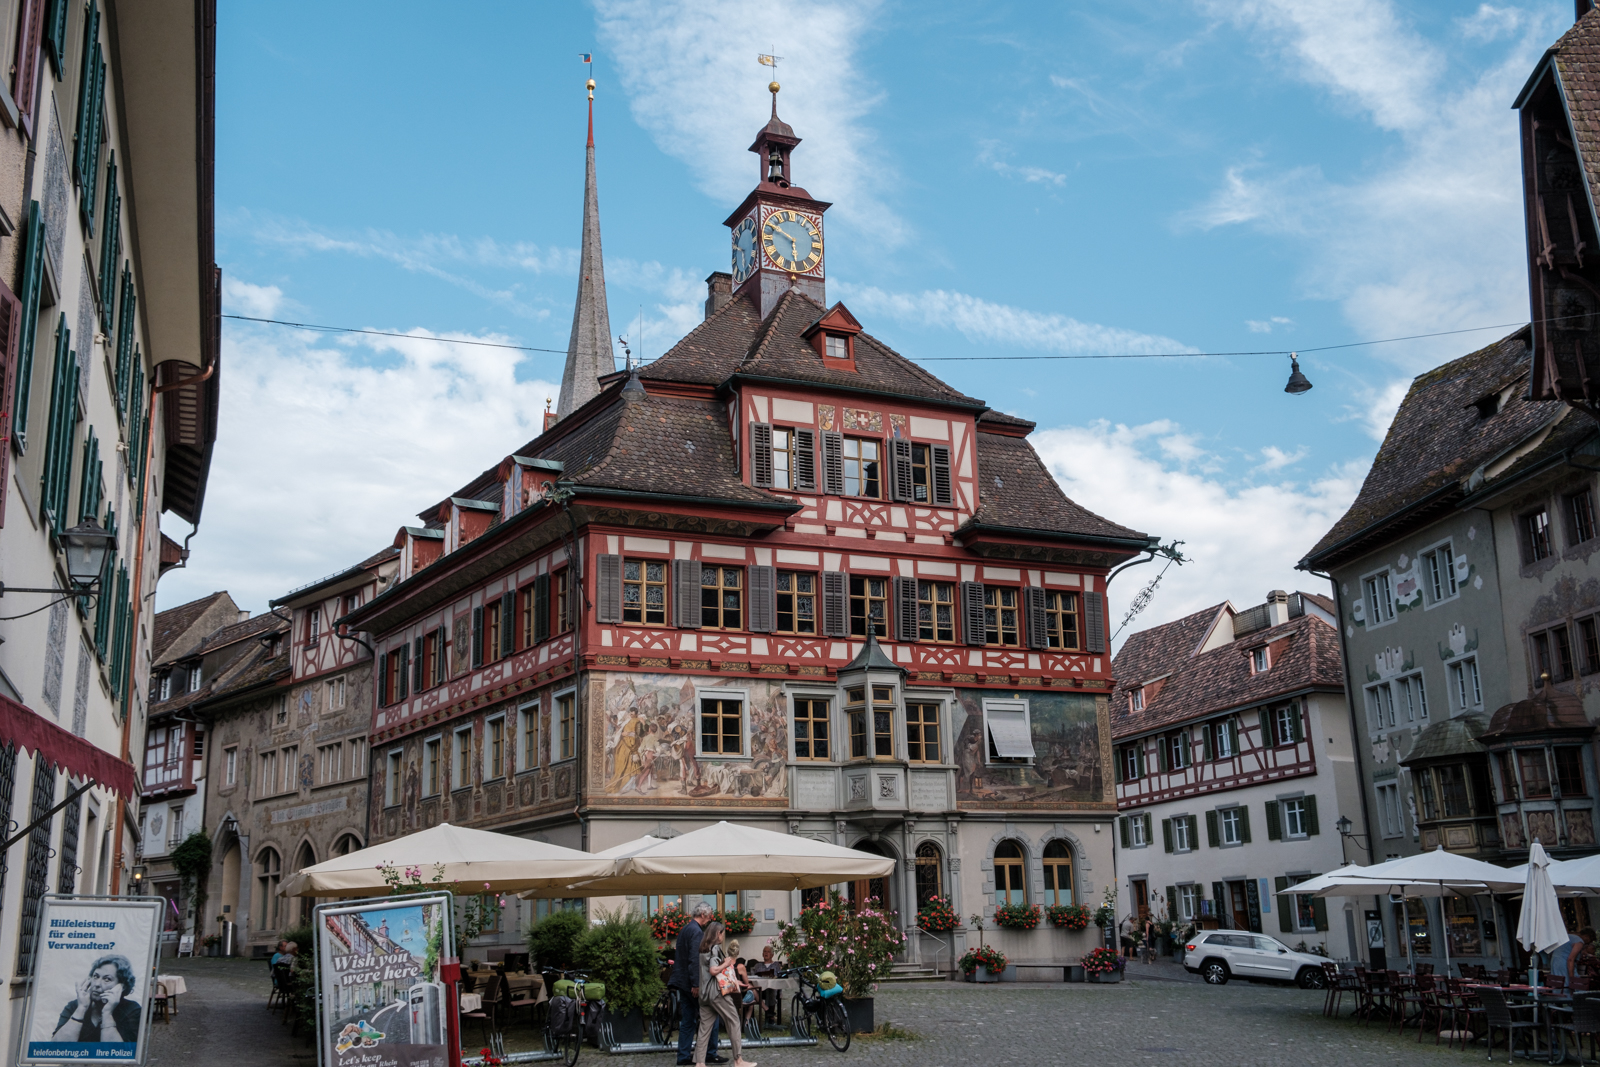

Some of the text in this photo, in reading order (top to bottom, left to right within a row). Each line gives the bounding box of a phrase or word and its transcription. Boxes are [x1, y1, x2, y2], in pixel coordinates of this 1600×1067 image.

[50, 919, 116, 930] Hilfeleistung
[48, 930, 96, 939] für einen
[48, 941, 116, 950] Verwandten?
[334, 952, 408, 971] Wish you
[343, 965, 419, 985] were here
[33, 1049, 133, 1058] telefonbetrug.ch Ihre Polizei
[339, 1056, 360, 1066] Let's
[362, 1054, 382, 1063] keep
